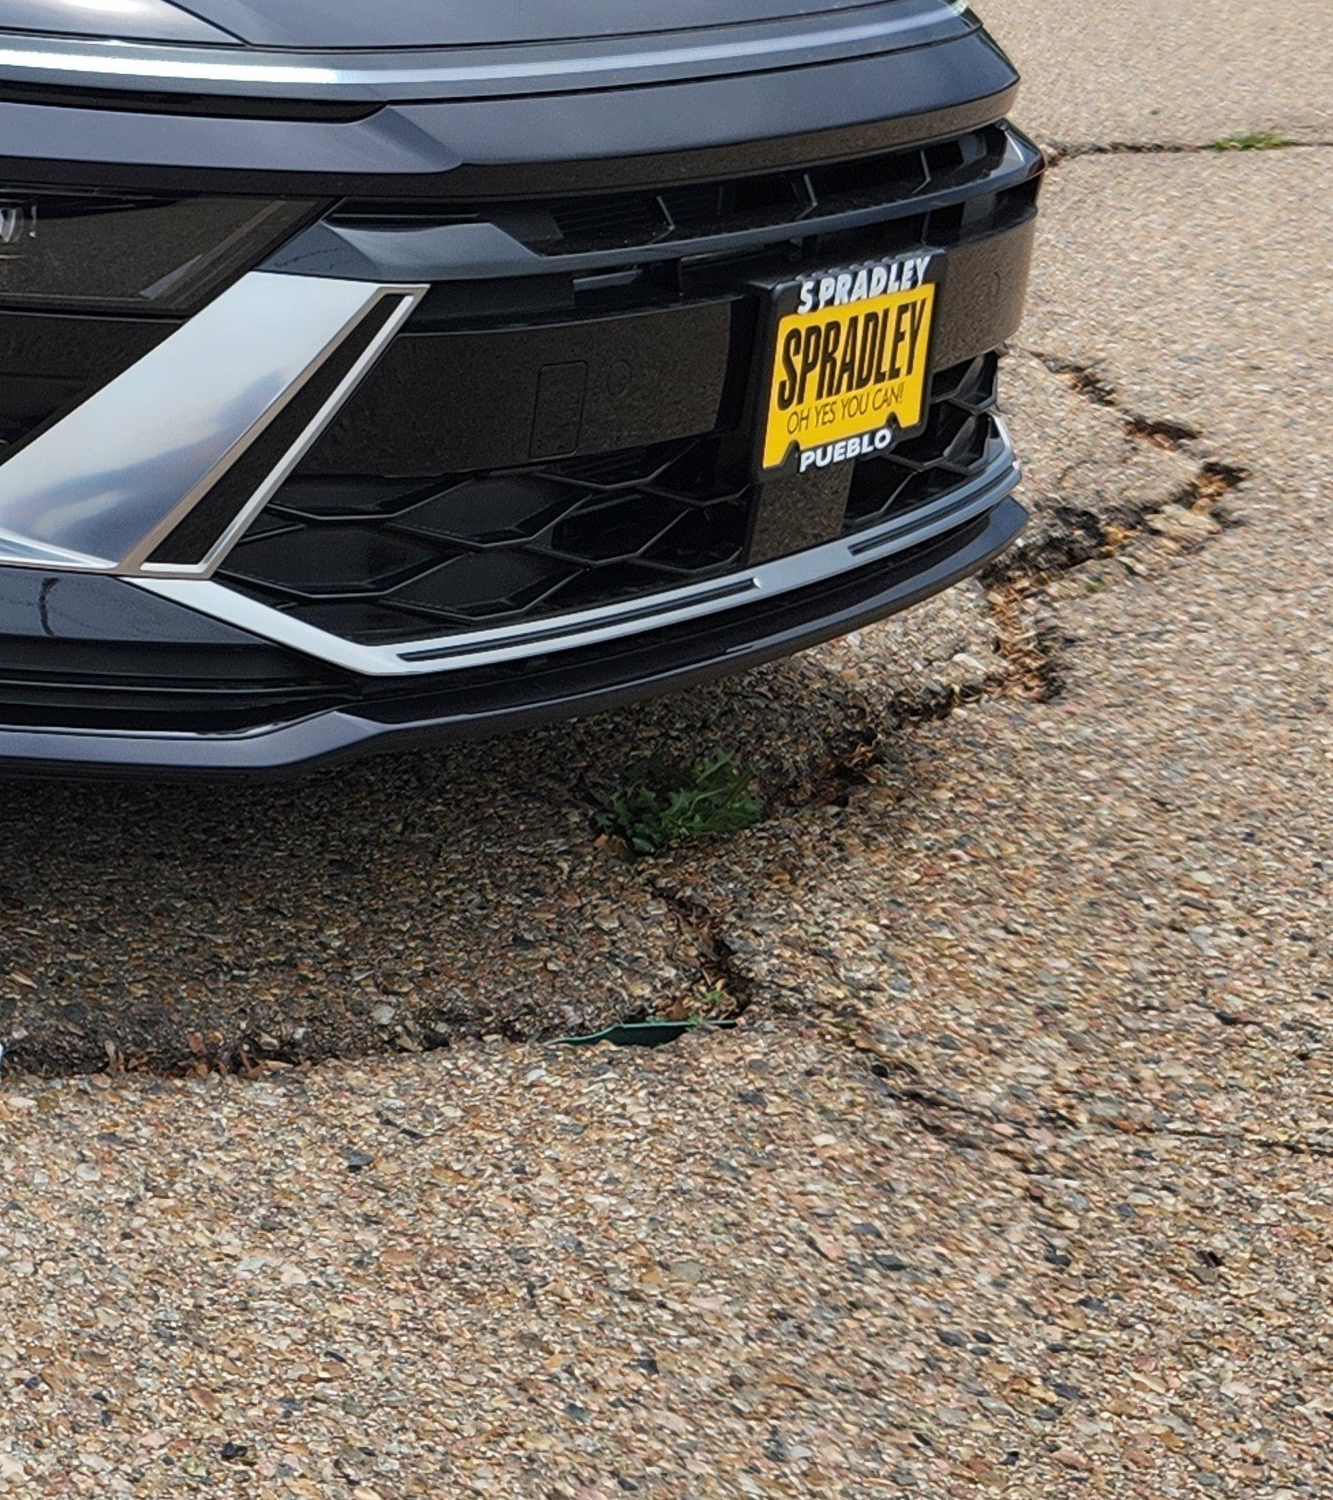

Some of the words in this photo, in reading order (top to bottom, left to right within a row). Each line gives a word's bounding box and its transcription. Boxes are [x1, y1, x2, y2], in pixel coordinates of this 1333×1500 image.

[797, 256, 932, 314] SPRADLEY
[777, 297, 928, 411] SPRADLEY
[787, 408, 811, 434] OH
[815, 401, 837, 428] YES
[841, 392, 870, 422] YOU
[872, 382, 905, 411] CAN!
[799, 428, 892, 473] PUEBLO
